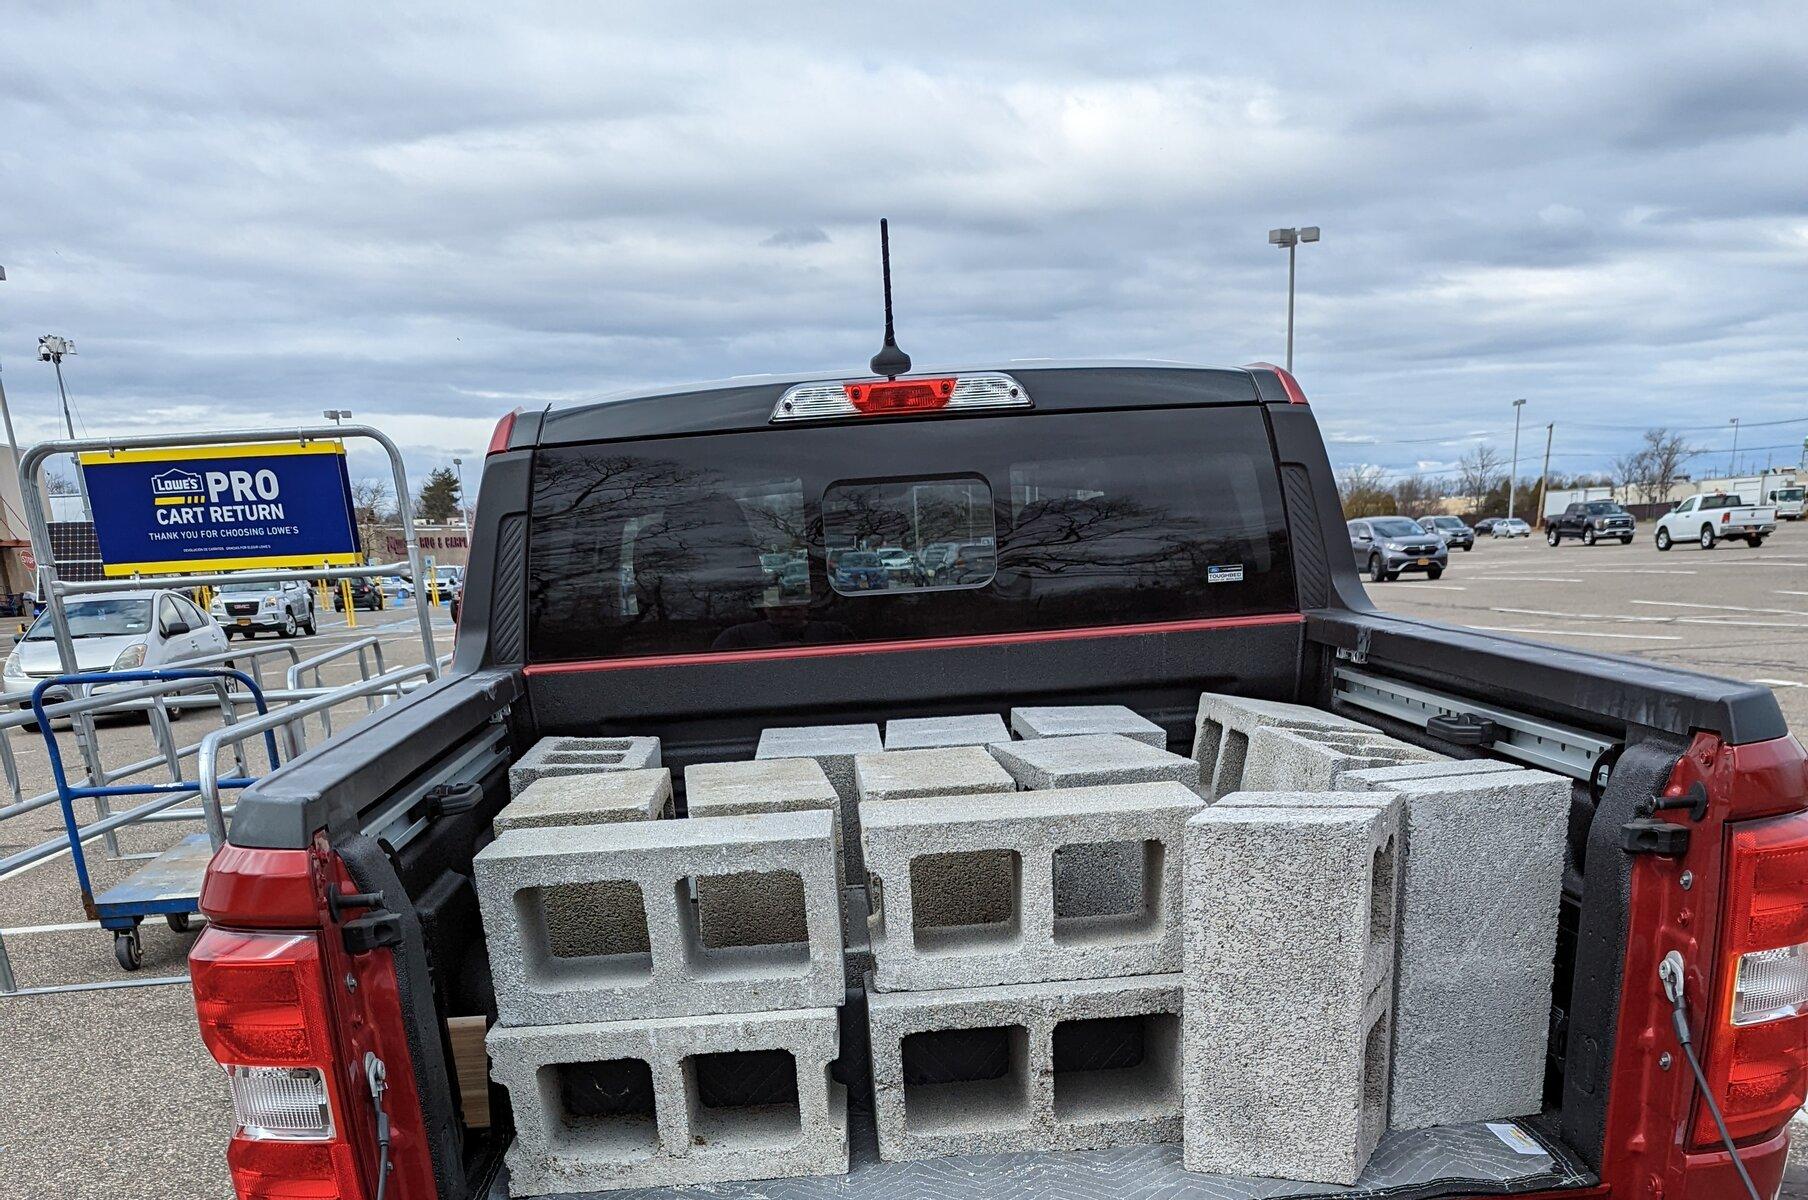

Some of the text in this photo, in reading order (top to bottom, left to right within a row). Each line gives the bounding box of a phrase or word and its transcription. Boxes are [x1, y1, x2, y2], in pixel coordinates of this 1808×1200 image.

[156, 469, 280, 503] LOWE'S PRO
[156, 503, 285, 525] CART RETURN
[149, 526, 300, 541] THANK YOU FOR CHOOSING LOWE'S
